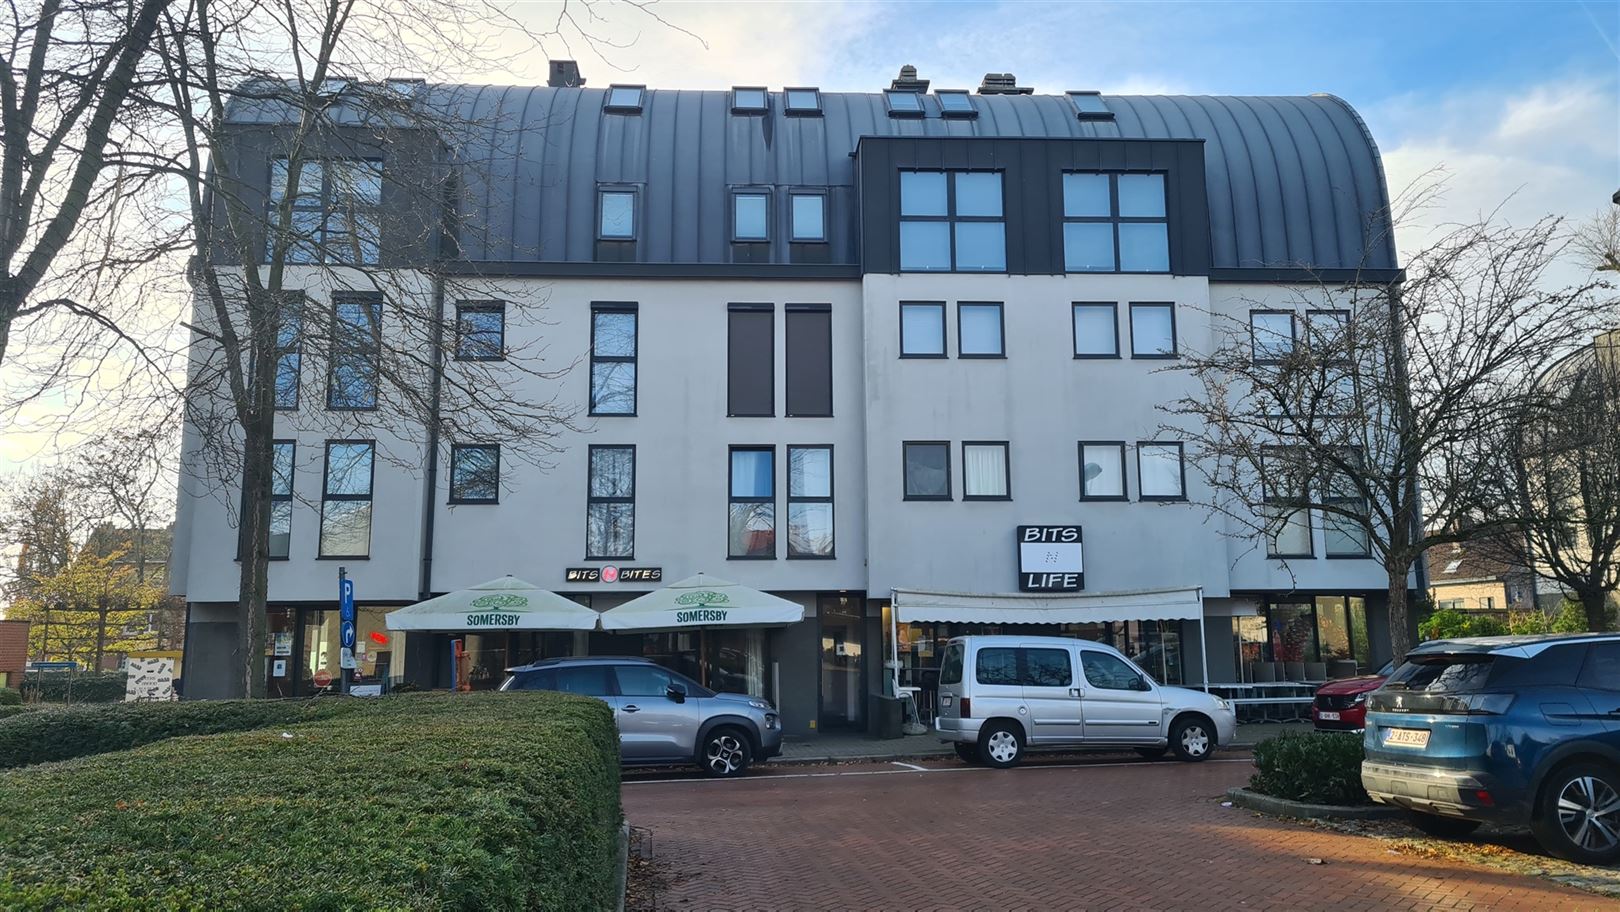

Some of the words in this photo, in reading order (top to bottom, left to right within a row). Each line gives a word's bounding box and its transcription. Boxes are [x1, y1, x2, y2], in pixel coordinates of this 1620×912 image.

[1024, 527, 1078, 541] BITS
[567, 570, 599, 580] BITS
[620, 570, 661, 580] BITES
[1028, 574, 1078, 588] LIFE
[344, 582, 351, 604] P
[466, 613, 521, 626] SOMERSBY
[676, 610, 728, 623] SOMERSBY
